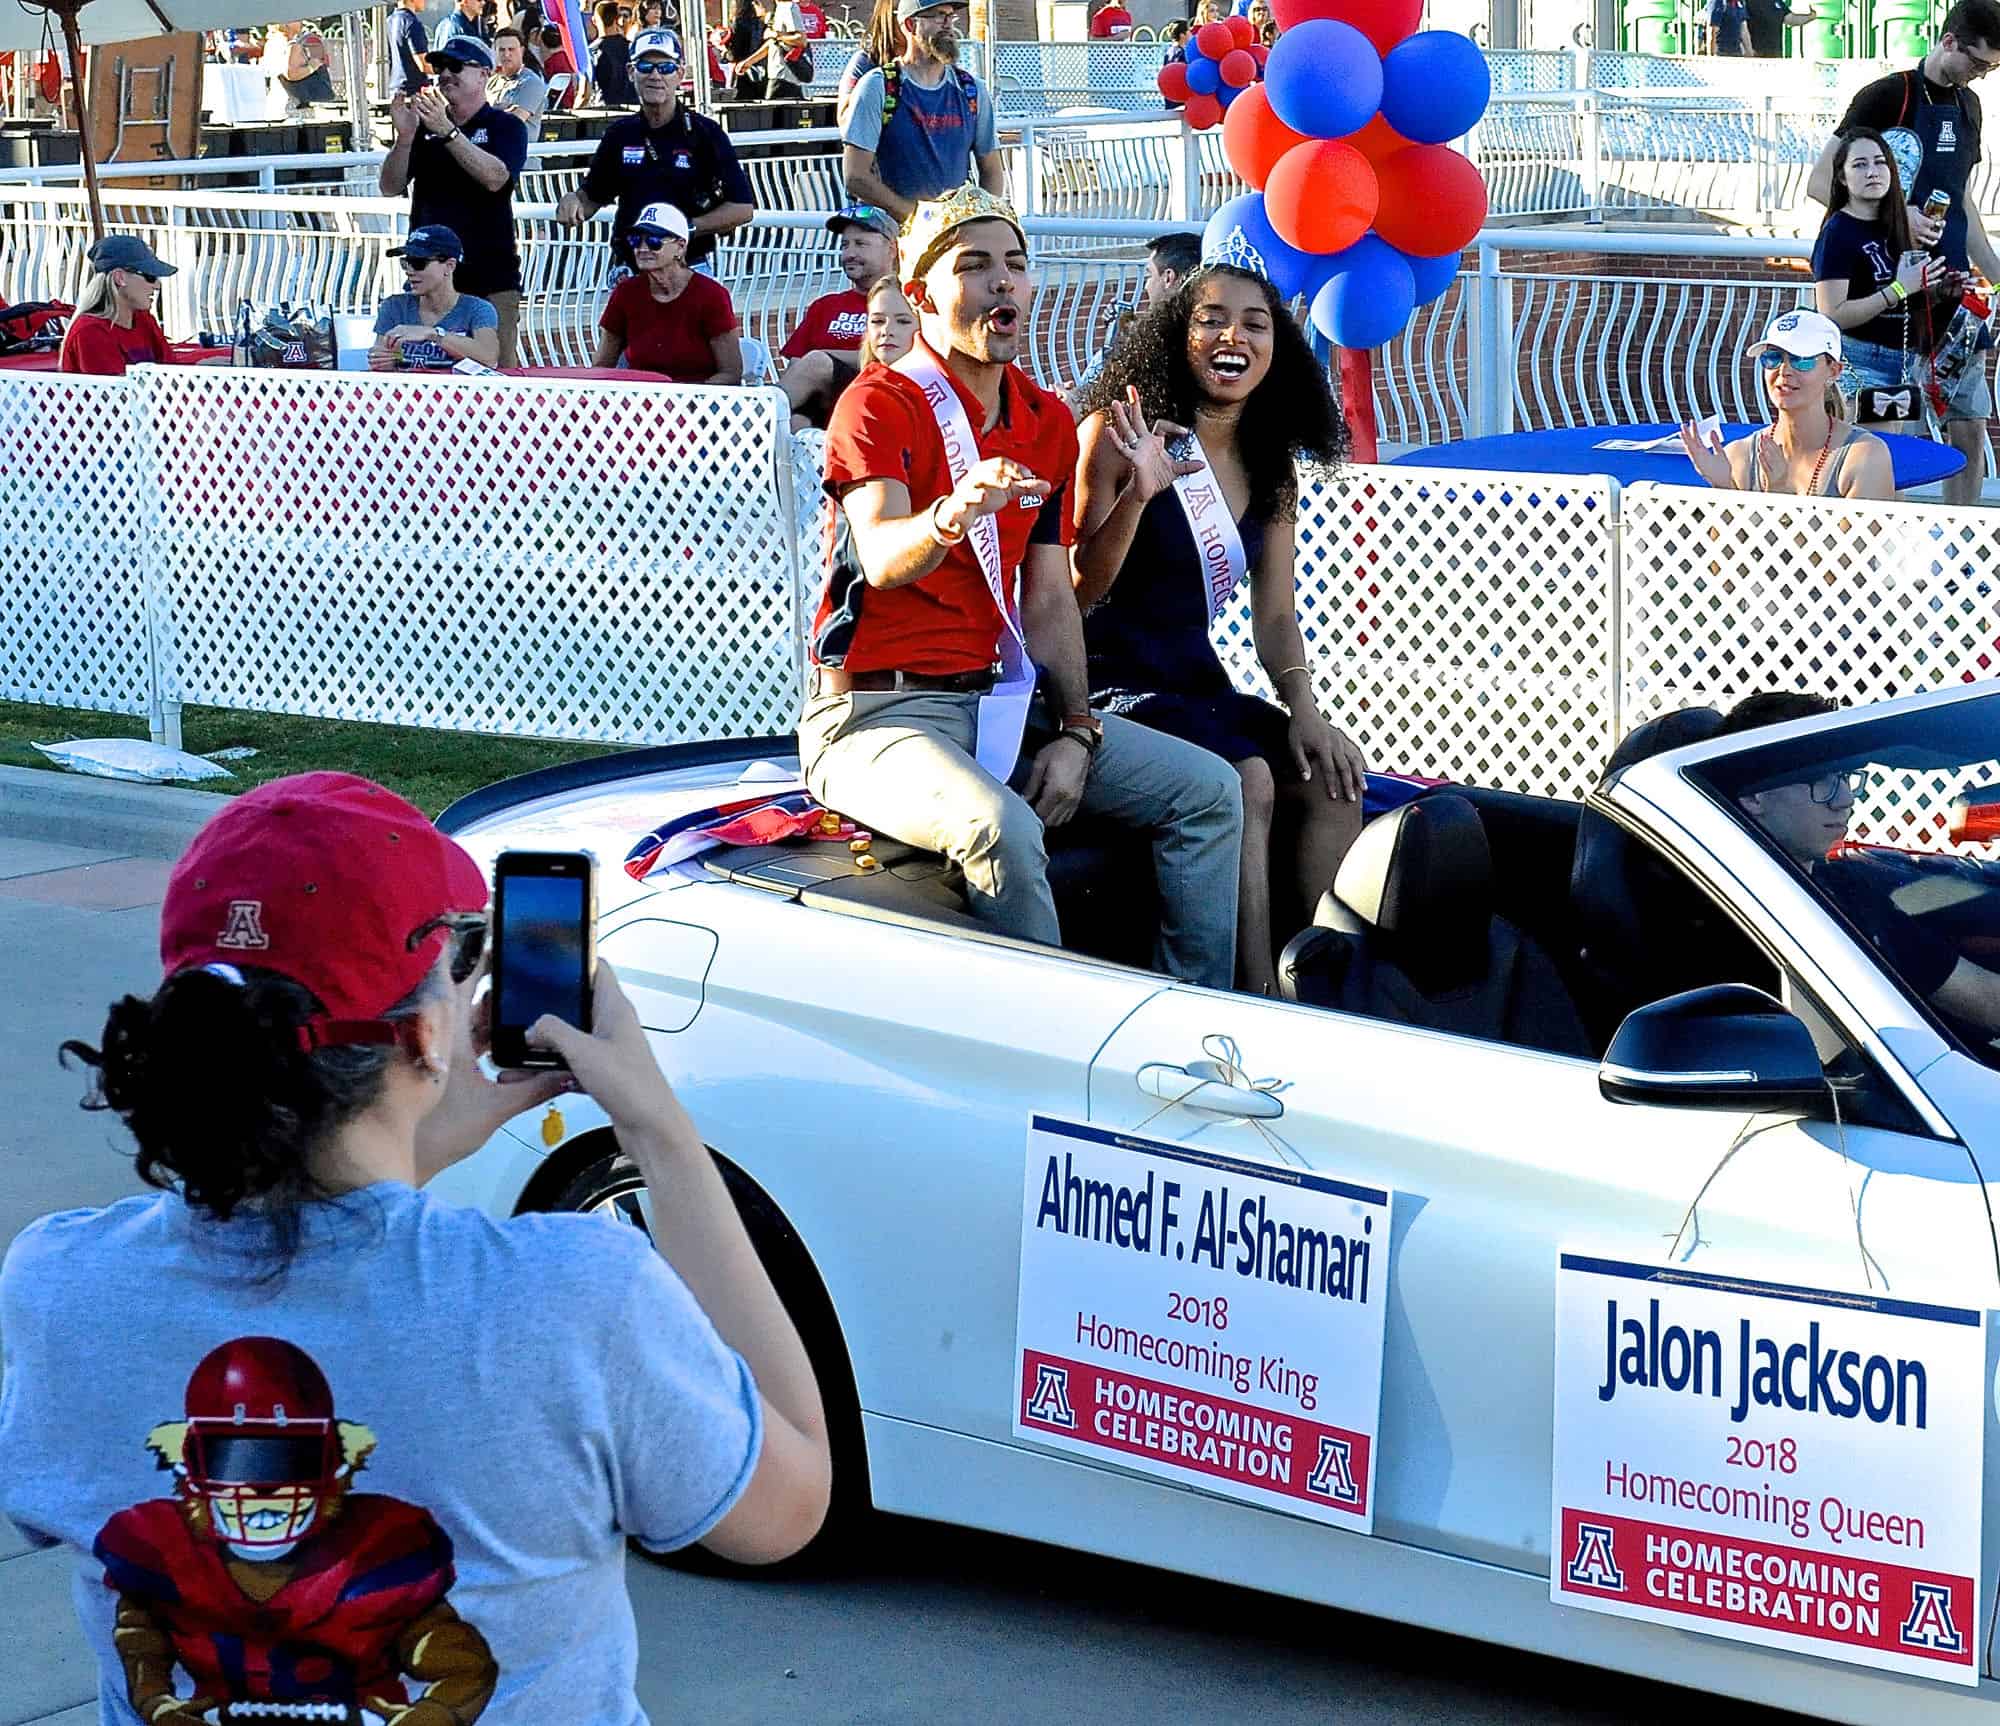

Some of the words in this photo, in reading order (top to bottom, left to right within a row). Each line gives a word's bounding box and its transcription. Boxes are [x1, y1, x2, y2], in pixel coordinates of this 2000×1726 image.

[640, 207, 657, 221] A
[827, 320, 867, 332] DOW
[837, 312, 867, 321] BEA
[283, 341, 307, 363] A
[1184, 484, 1217, 520] A
[1200, 523, 1234, 613] HOMEC
[216, 900, 269, 949] A
[1037, 1153, 1154, 1252] Ahmed
[1160, 1182, 1184, 1261] F.
[1191, 1187, 1373, 1304] Al-Shamari
[1167, 1292, 1229, 1330] 2018
[1076, 1311, 1252, 1393] Homecoming
[1259, 1356, 1320, 1411] King
[1598, 1299, 1722, 1402] Jalon
[1730, 1319, 1927, 1429] Jackson
[1027, 1364, 1075, 1429] A
[1095, 1377, 1293, 1452] HOMECOMING
[1093, 1410, 1291, 1484] CELEBRATION
[1306, 1435, 1359, 1503] A
[1725, 1436, 1798, 1474] 2018
[1605, 1460, 1811, 1537] Homecoming
[1819, 1497, 1925, 1549] Queen
[1568, 1522, 1624, 1592] A
[1646, 1534, 1880, 1602] HOMECOMING
[1646, 1569, 1880, 1637] CELEBRATION
[1899, 1582, 1964, 1654] A
